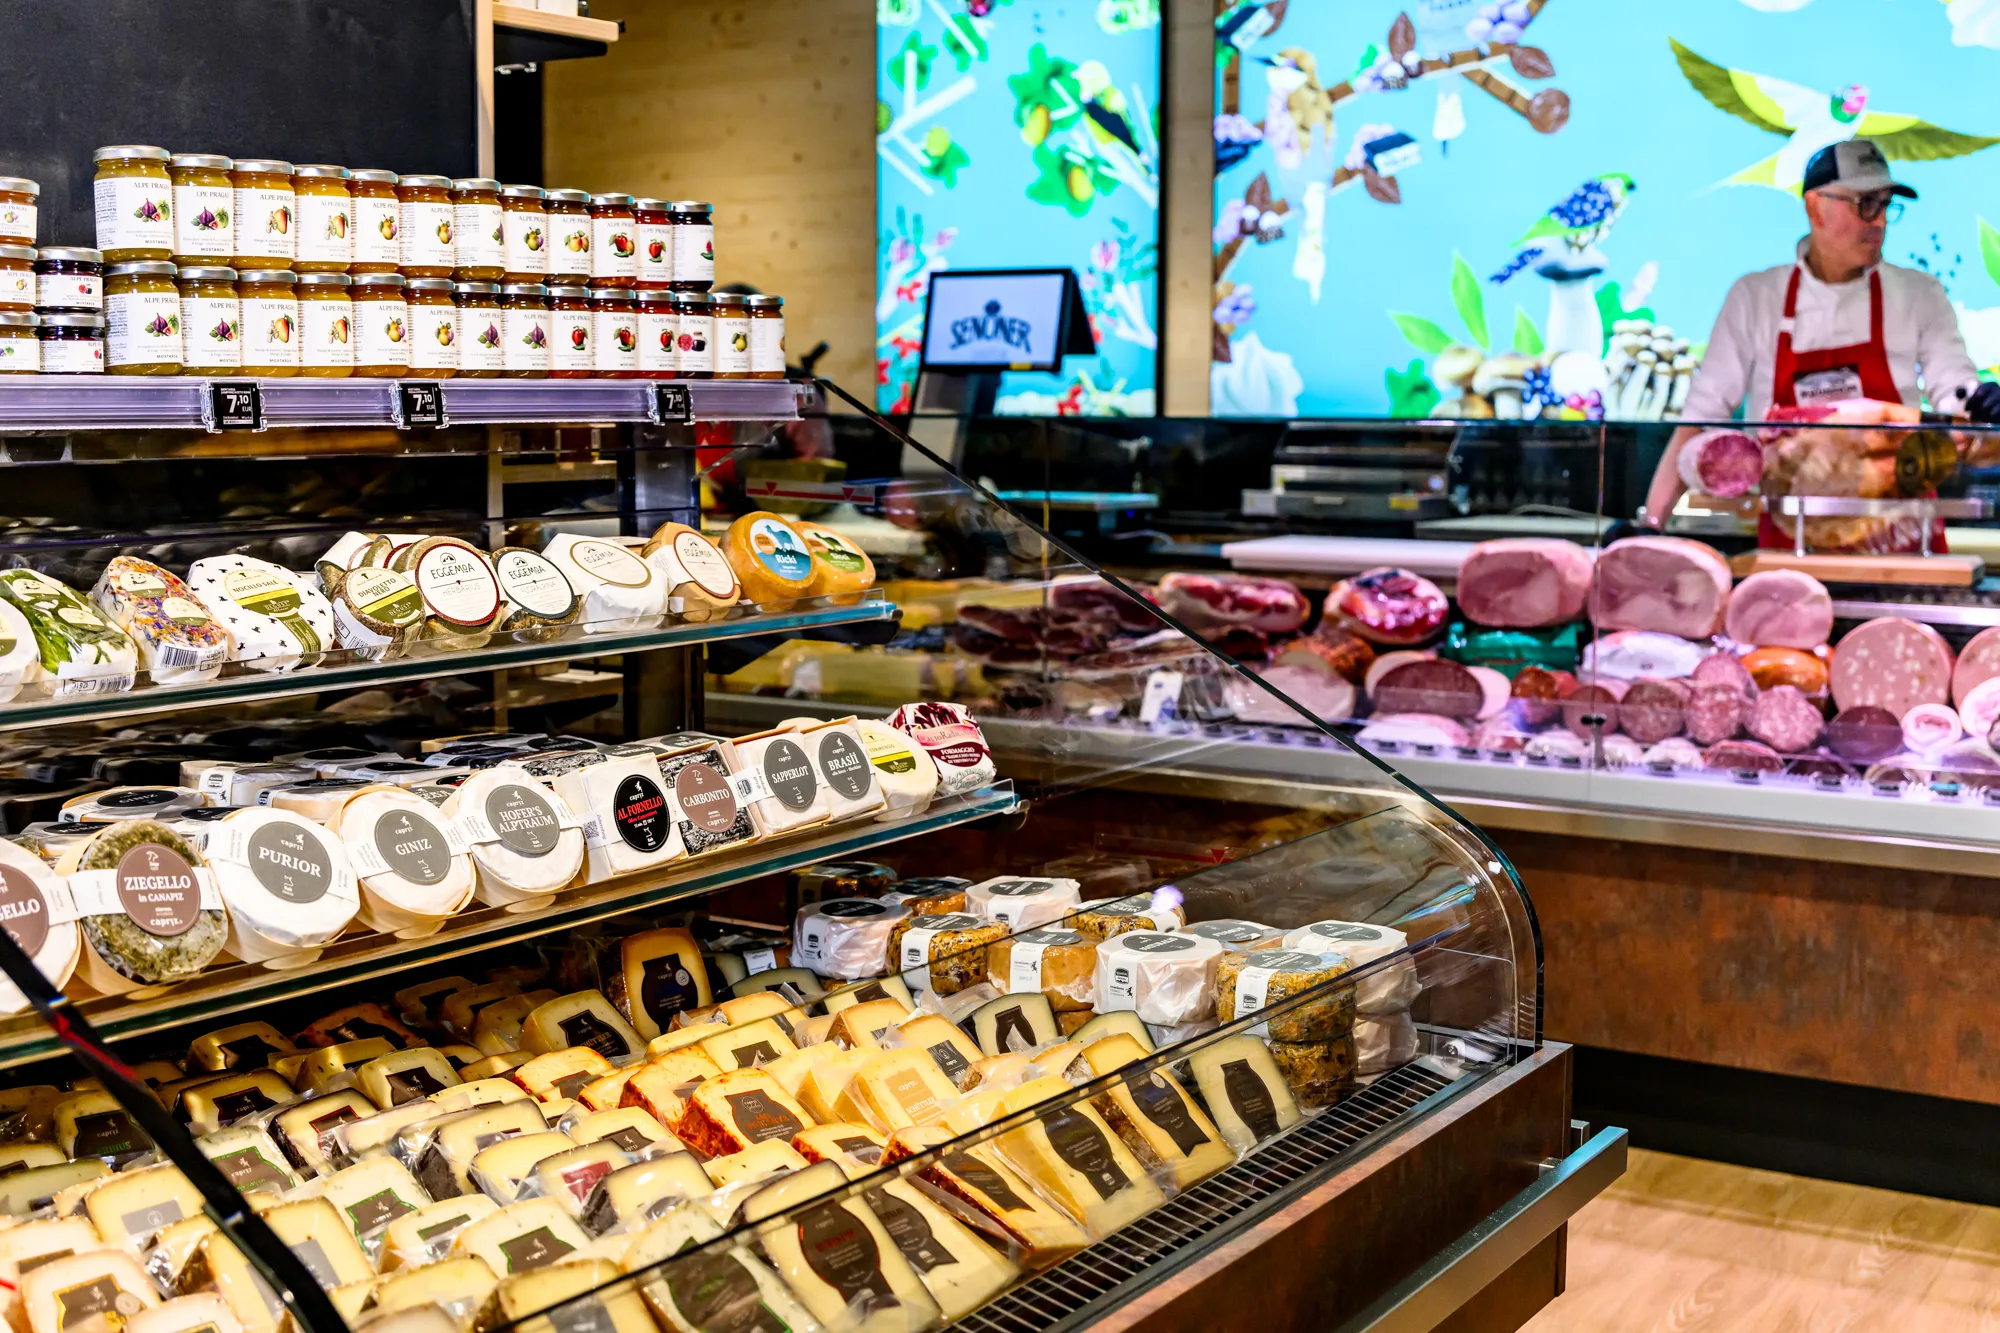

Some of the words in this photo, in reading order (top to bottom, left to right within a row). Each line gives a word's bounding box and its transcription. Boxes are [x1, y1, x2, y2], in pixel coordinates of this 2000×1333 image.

[226, 394, 249, 414] 7,10
[412, 393, 433, 412] 7,10
[666, 393, 683, 410] 7,10
[430, 562, 476, 580] EGGEMOA
[507, 565, 547, 580] EGGEMOA
[232, 583, 263, 593] NOCILLO
[357, 577, 397, 598] DIAVOLETTO
[372, 586, 391, 597] NERO
[442, 582, 482, 596] HERBARIUS
[771, 765, 810, 784] SAPPERLOT
[506, 800, 525, 808] capriz
[629, 792, 645, 802] capriz
[682, 788, 731, 807] CARBONITO
[499, 805, 543, 822] HOFER'S
[617, 807, 629, 821] AL
[626, 795, 664, 817] FORNELLO
[394, 826, 414, 835] capriz
[498, 814, 555, 834] ALPTRAUM
[280, 839, 304, 851] capriz
[395, 838, 432, 856] GINIZ
[258, 846, 322, 878] PURIOR
[123, 875, 192, 891] ZIEGELLO
[138, 893, 148, 903] in
[147, 892, 184, 902] CANAPIZ
[406, 1083, 425, 1092] capriz
[236, 1103, 256, 1113] capriz
[905, 1096, 936, 1115] SCHÜTTLER
[96, 1129, 120, 1138] capriz
[231, 1167, 253, 1179] capriz
[525, 1249, 549, 1261] capriz
